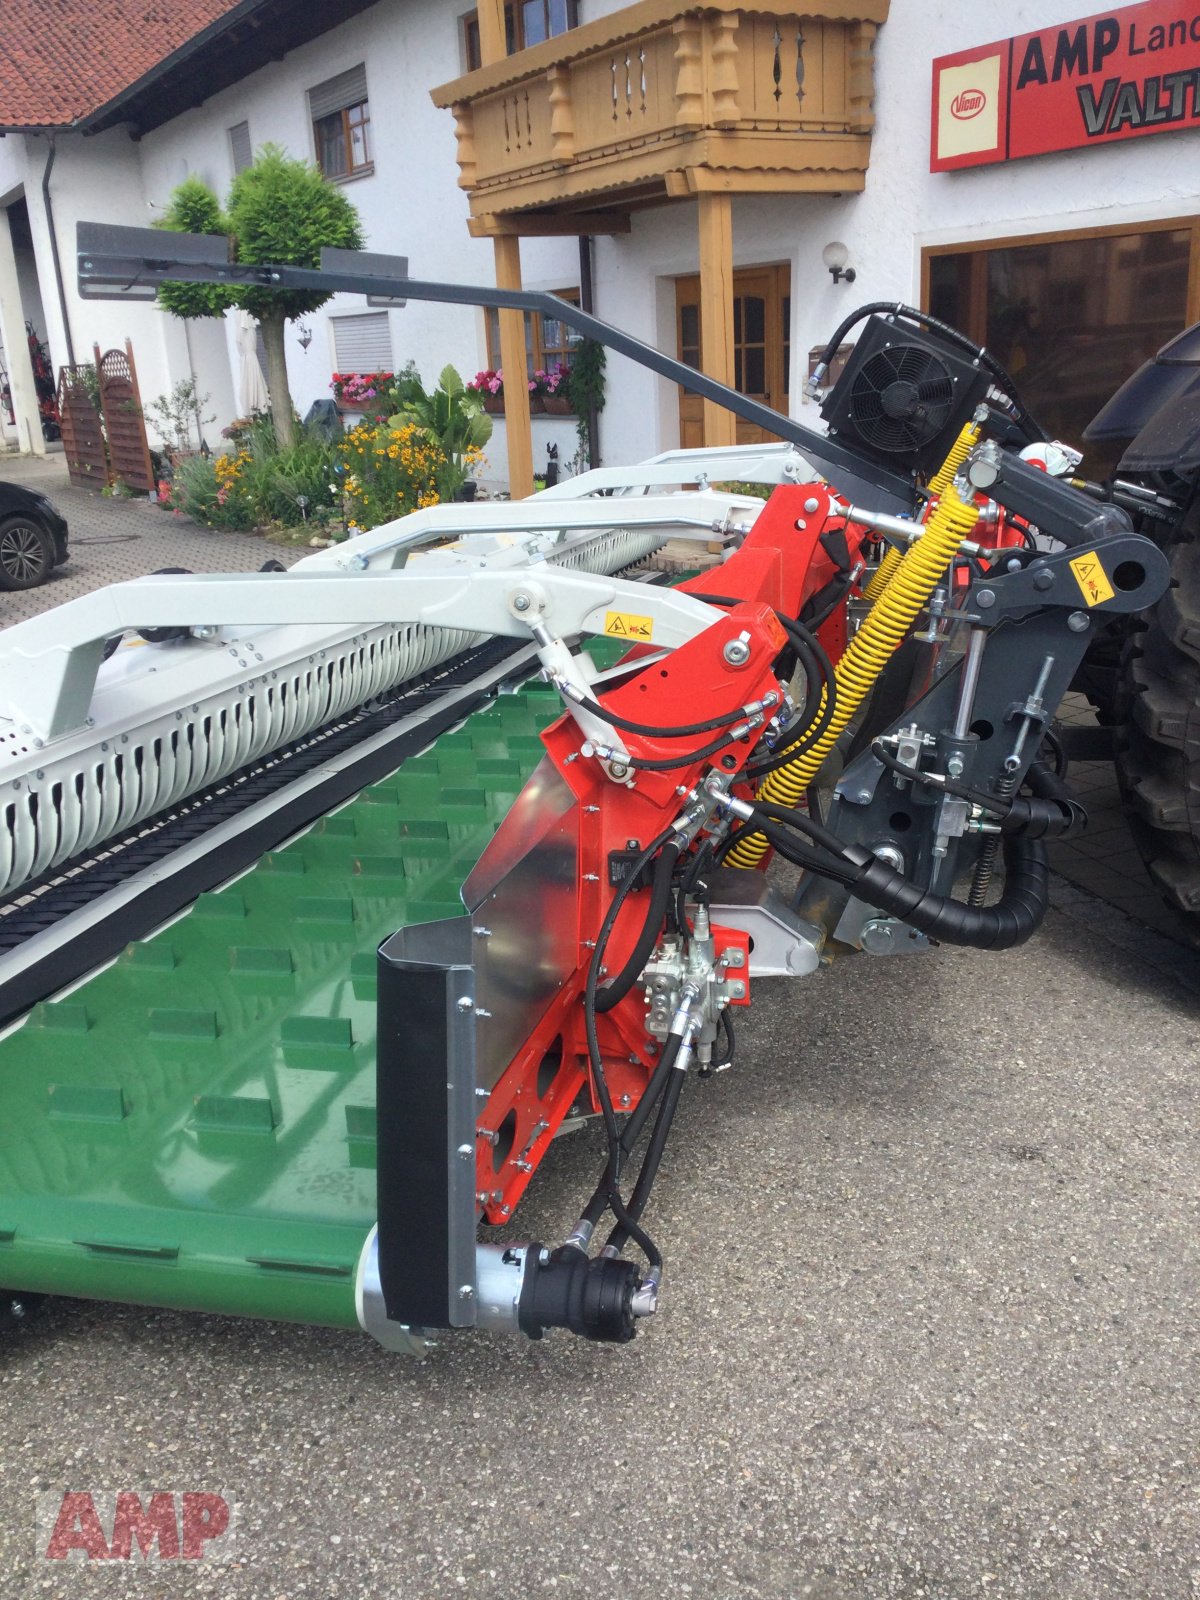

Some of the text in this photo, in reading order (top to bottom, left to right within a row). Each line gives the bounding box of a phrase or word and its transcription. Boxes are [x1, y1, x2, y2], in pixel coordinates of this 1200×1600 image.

[1016, 18, 1120, 91] AMP
[954, 92, 983, 114] Vicon
[1076, 67, 1200, 137] VALT
